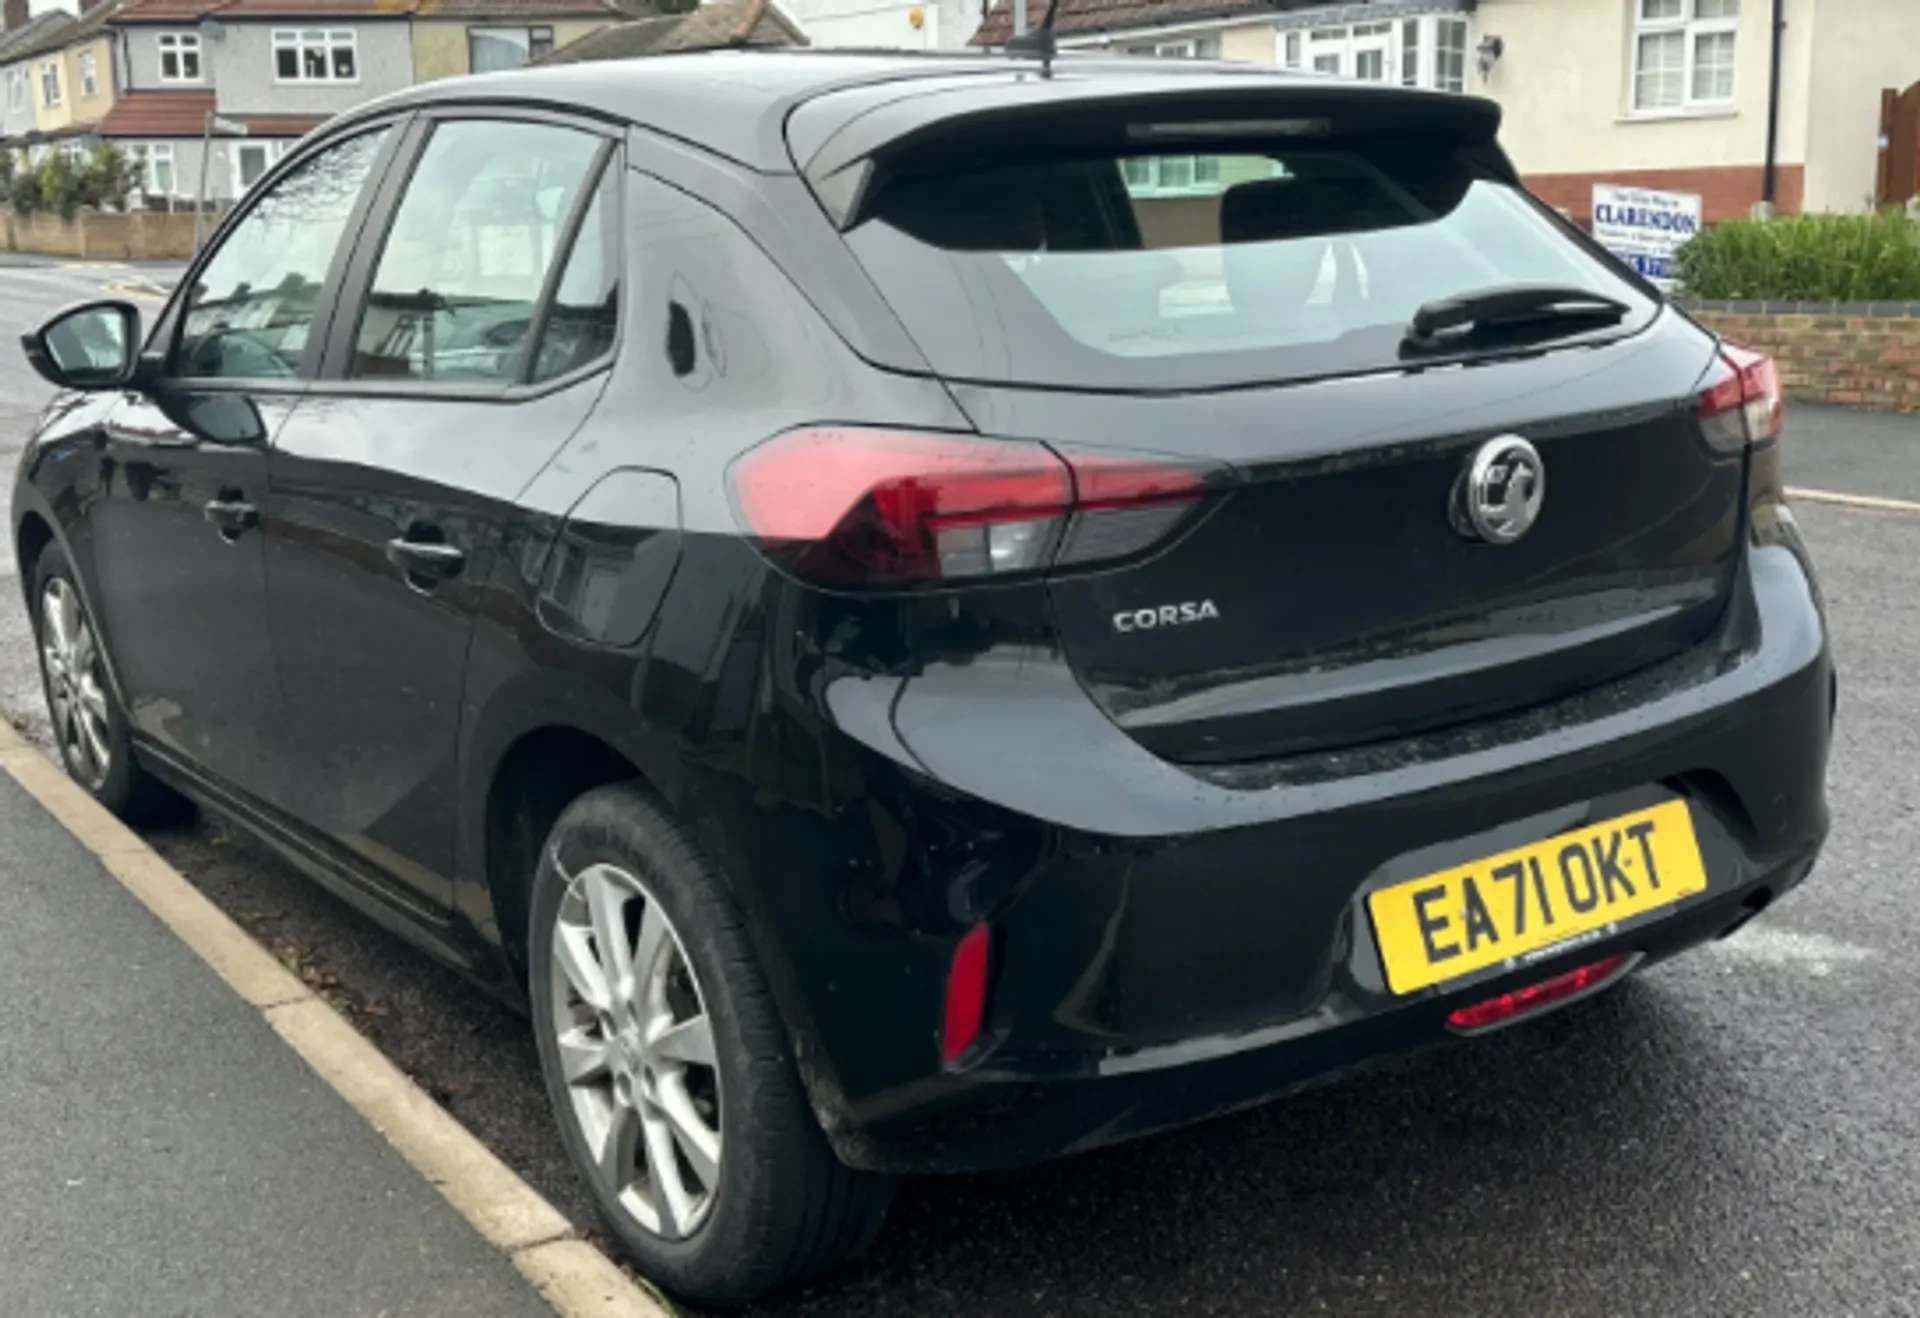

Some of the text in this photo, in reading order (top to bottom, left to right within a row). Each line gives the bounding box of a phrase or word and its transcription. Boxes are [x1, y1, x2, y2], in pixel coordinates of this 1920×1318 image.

[1596, 203, 1696, 234] CLARENDON
[1112, 598, 1220, 632] CORSA
[1412, 856, 1556, 964] EA71
[1558, 820, 1661, 915] OKT
